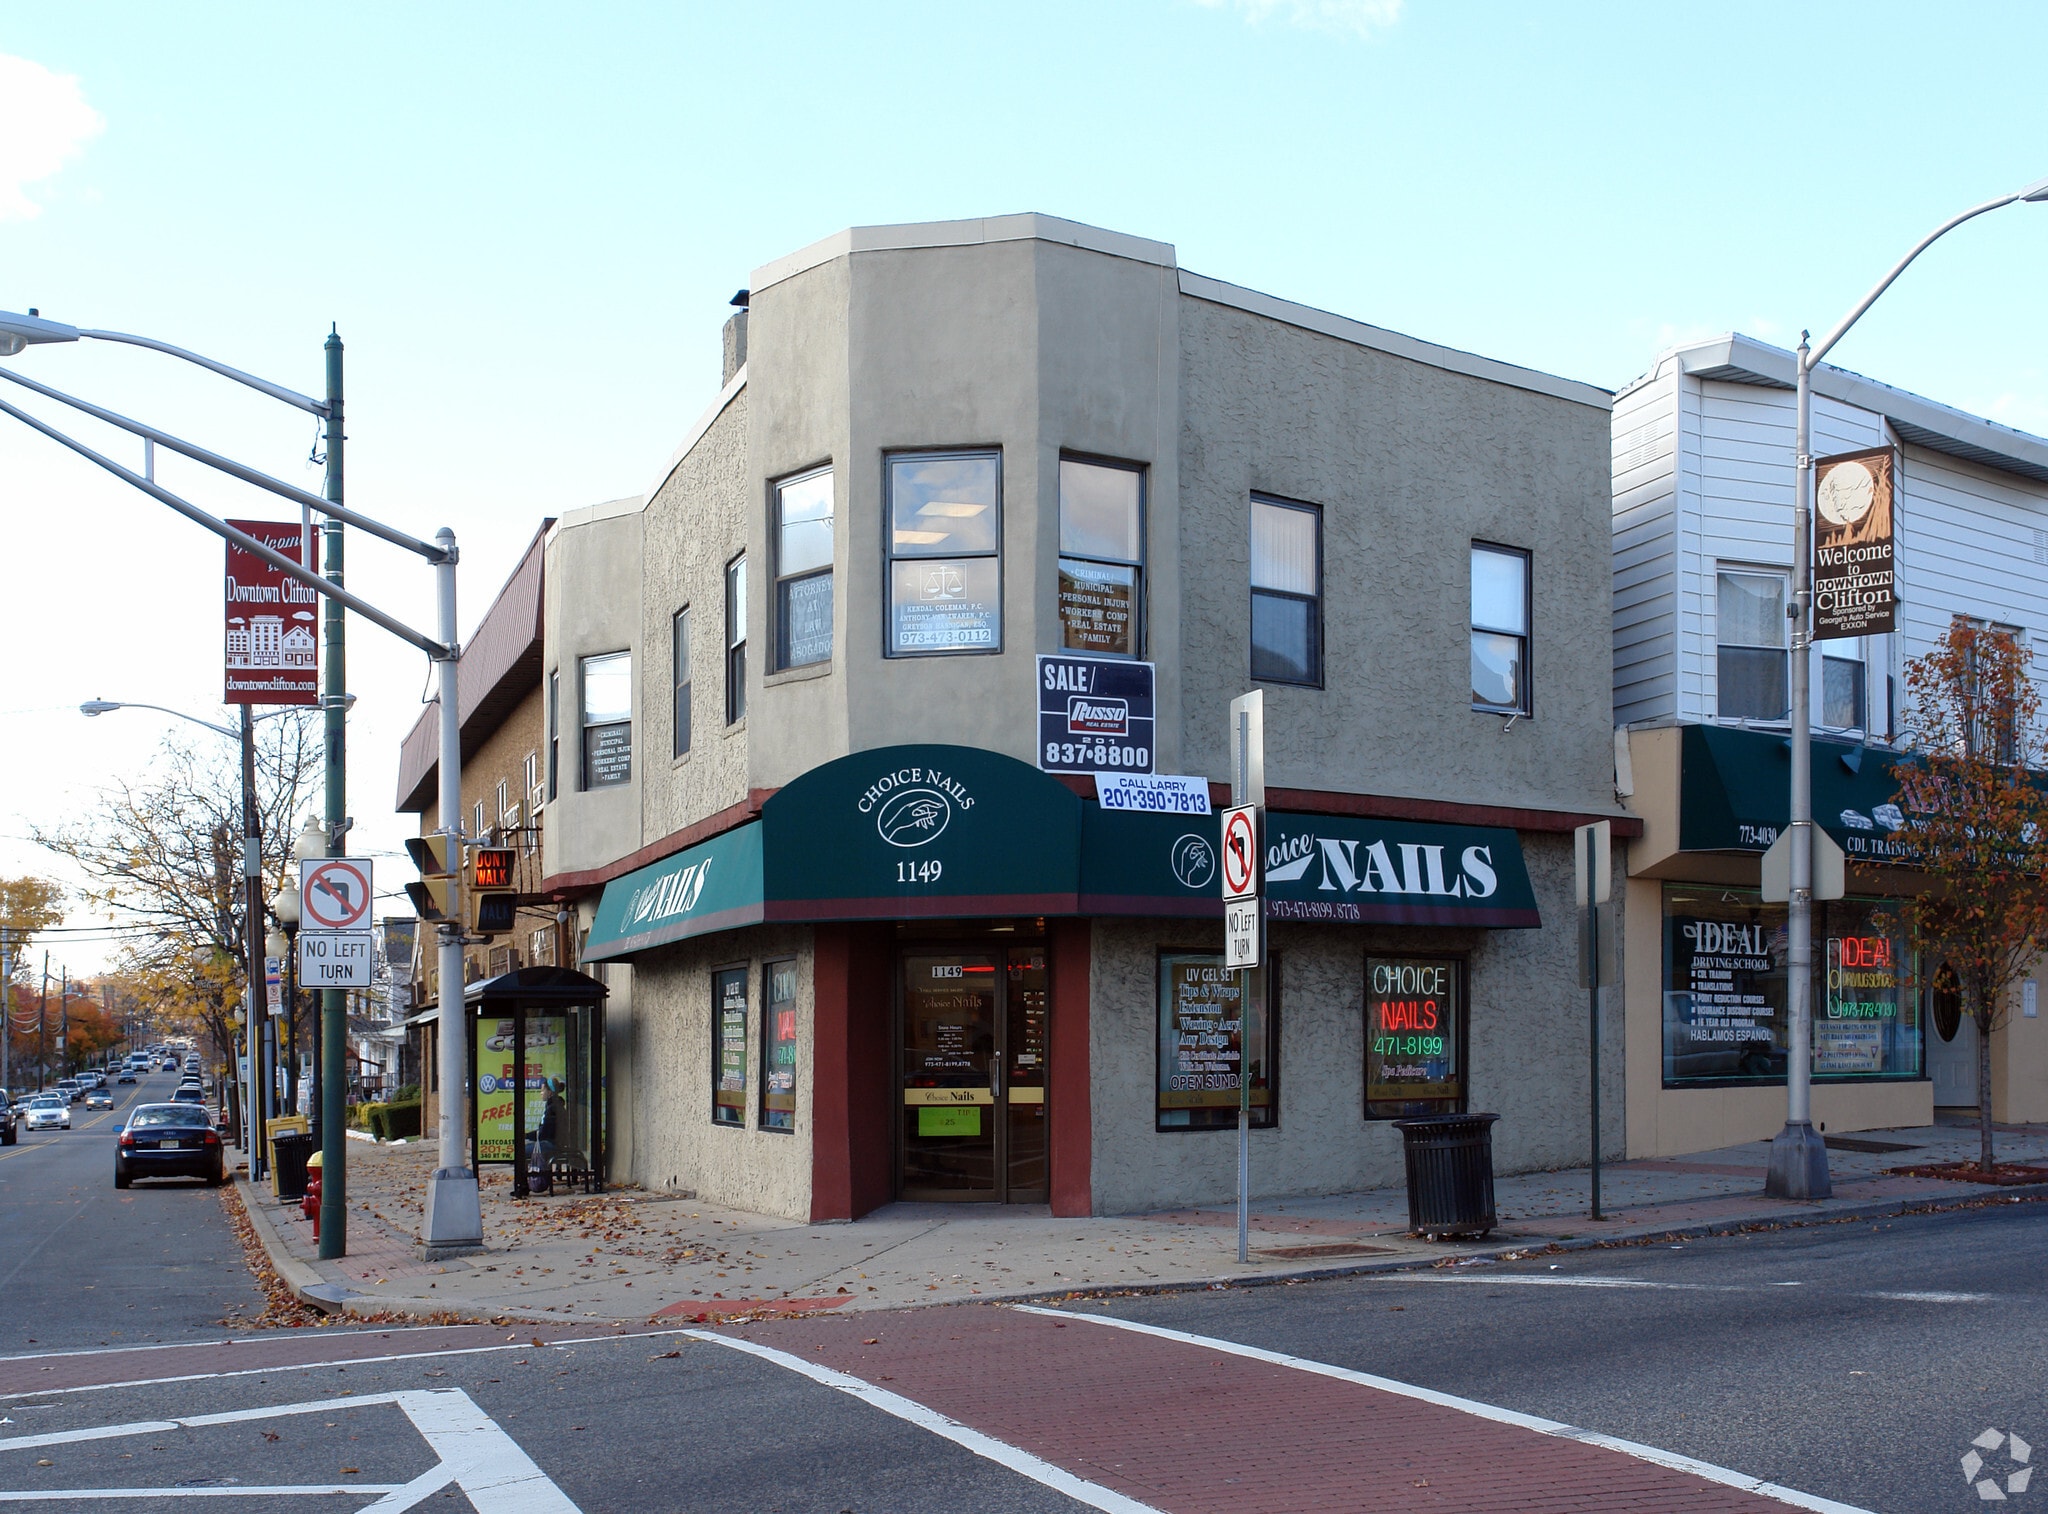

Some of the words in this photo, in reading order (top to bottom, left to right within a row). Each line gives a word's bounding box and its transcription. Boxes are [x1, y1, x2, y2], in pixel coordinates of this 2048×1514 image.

[1817, 544, 1892, 567] Welcome
[1847, 564, 1860, 575] to
[227, 575, 280, 603] Downtown
[281, 577, 316, 604] Clifton
[1074, 581, 1114, 594] MUNICIPAL
[1817, 571, 1892, 591] DOWNTOWN
[1062, 592, 1101, 605] PERSONAL
[1104, 597, 1130, 609] INJURY
[1816, 588, 1892, 610] Clifton
[907, 605, 933, 613] KENDAL
[935, 603, 969, 612] COLEMAN,
[1106, 612, 1128, 621] COMP
[1832, 605, 1867, 616] Sponsored
[1867, 604, 1876, 612] by
[899, 614, 931, 622] ANTHONY
[1071, 620, 1091, 630] REAL
[1093, 622, 1122, 633] ESTATE
[1819, 616, 1848, 625] George's
[1849, 613, 1864, 621] Auto
[1865, 611, 1890, 619] Service
[1840, 621, 1868, 631] EXXON
[901, 630, 990, 644] 973-473-0112
[1083, 633, 1111, 643] FAMILY
[227, 676, 316, 691] downtownclifton.com
[1070, 701, 1126, 722] RUSSO
[858, 768, 922, 813] CHOICE
[926, 769, 975, 810] NAILS
[1119, 778, 1147, 789] CALL
[1150, 780, 1187, 792] LARRY
[1739, 825, 1777, 845] 773-4030
[1847, 836, 1868, 853] CDL
[476, 851, 507, 868] DONT
[1265, 833, 1315, 870] oice
[1315, 838, 1498, 899] NAILS
[475, 869, 507, 885] WALK
[896, 860, 942, 883] 1149
[647, 856, 714, 922] NAILS
[1228, 912, 1239, 933] NO
[1240, 914, 1255, 932] LEFT
[1234, 938, 1250, 956] TURN
[1694, 921, 1769, 956] IDEAL
[306, 941, 327, 958] NO
[334, 942, 366, 958] LEFT
[933, 966, 962, 977] 1149
[1693, 956, 1732, 969] DRIVING
[1733, 958, 1770, 970] SCHOOL
[319, 965, 353, 979] TURN
[1186, 968, 1200, 981] UV
[1201, 968, 1218, 981] GEL
[1220, 968, 1236, 982] SET
[1373, 965, 1446, 995] CHOICE
[1179, 983, 1198, 1000] Tips
[1200, 985, 1209, 998] &
[1211, 983, 1240, 1000] Wraps
[1742, 995, 1765, 1004] COURSES
[952, 995, 982, 1009] Nails
[1179, 1000, 1222, 1014] Extension
[1381, 1000, 1438, 1031] NAILS
[1179, 1017, 1213, 1032] Waxing
[1217, 1018, 1242, 1034] Acryl
[1179, 1032, 1198, 1048] Any
[1199, 1032, 1229, 1049] Design
[1690, 1030, 1735, 1041] HABLAMOS
[1374, 1036, 1443, 1056] 471-8199
[1170, 1074, 1205, 1091] OPEN
[950, 1090, 975, 1101] Nails
[480, 1102, 514, 1124] FREE
